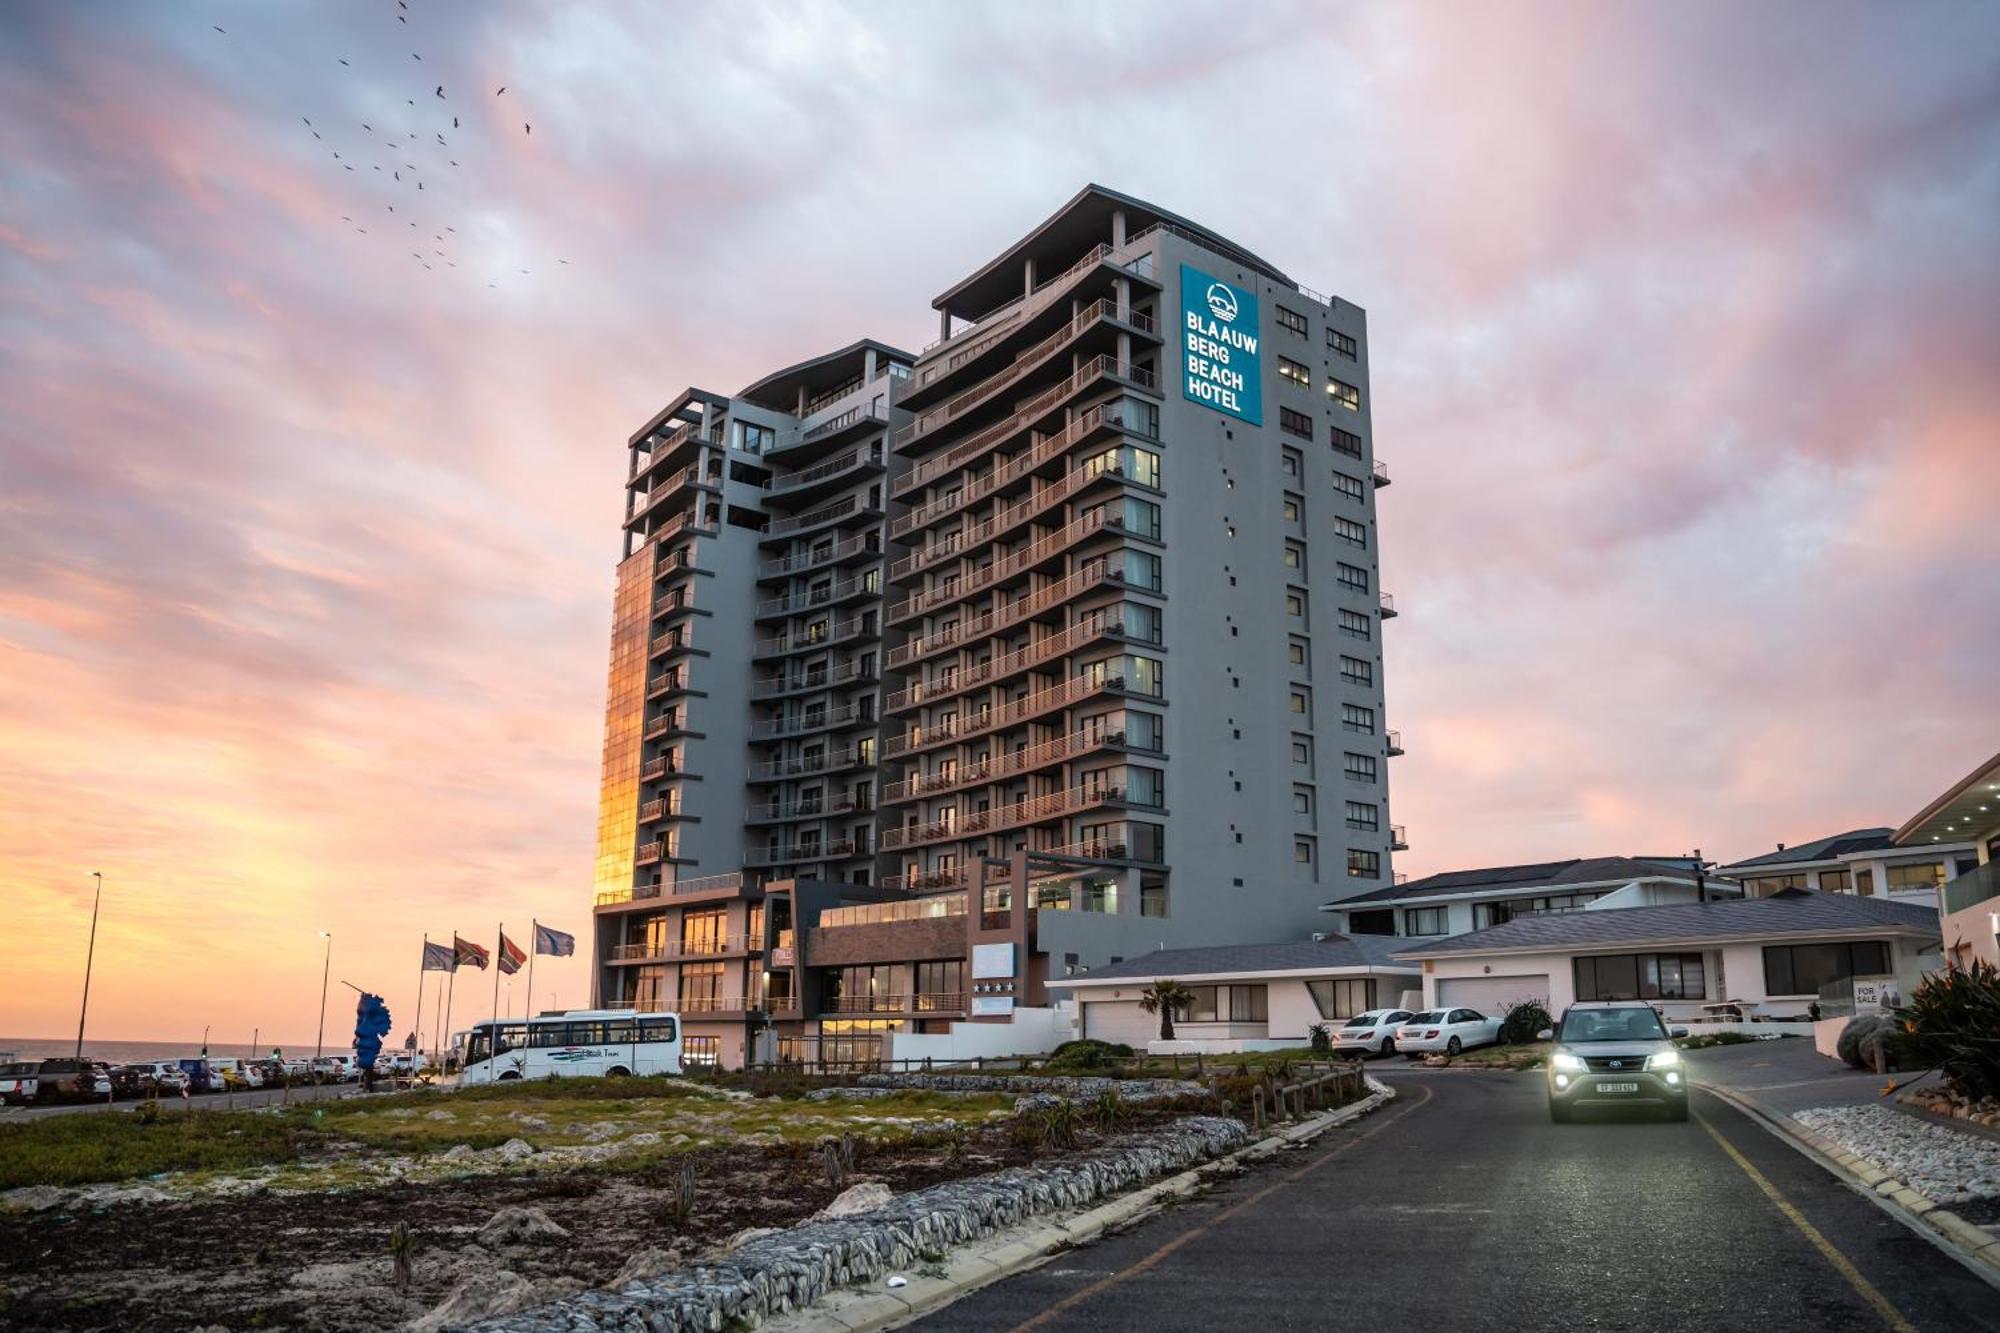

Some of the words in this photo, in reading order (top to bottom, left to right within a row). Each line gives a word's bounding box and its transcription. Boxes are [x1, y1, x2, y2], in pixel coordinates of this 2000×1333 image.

[1187, 311, 1257, 355] BLAAUW
[1187, 333, 1230, 364] BERG
[1188, 355, 1243, 392] BEACH
[1189, 376, 1241, 412] HOTEL
[1857, 995, 1878, 1003] SALE
[1858, 987, 1874, 995] FOR
